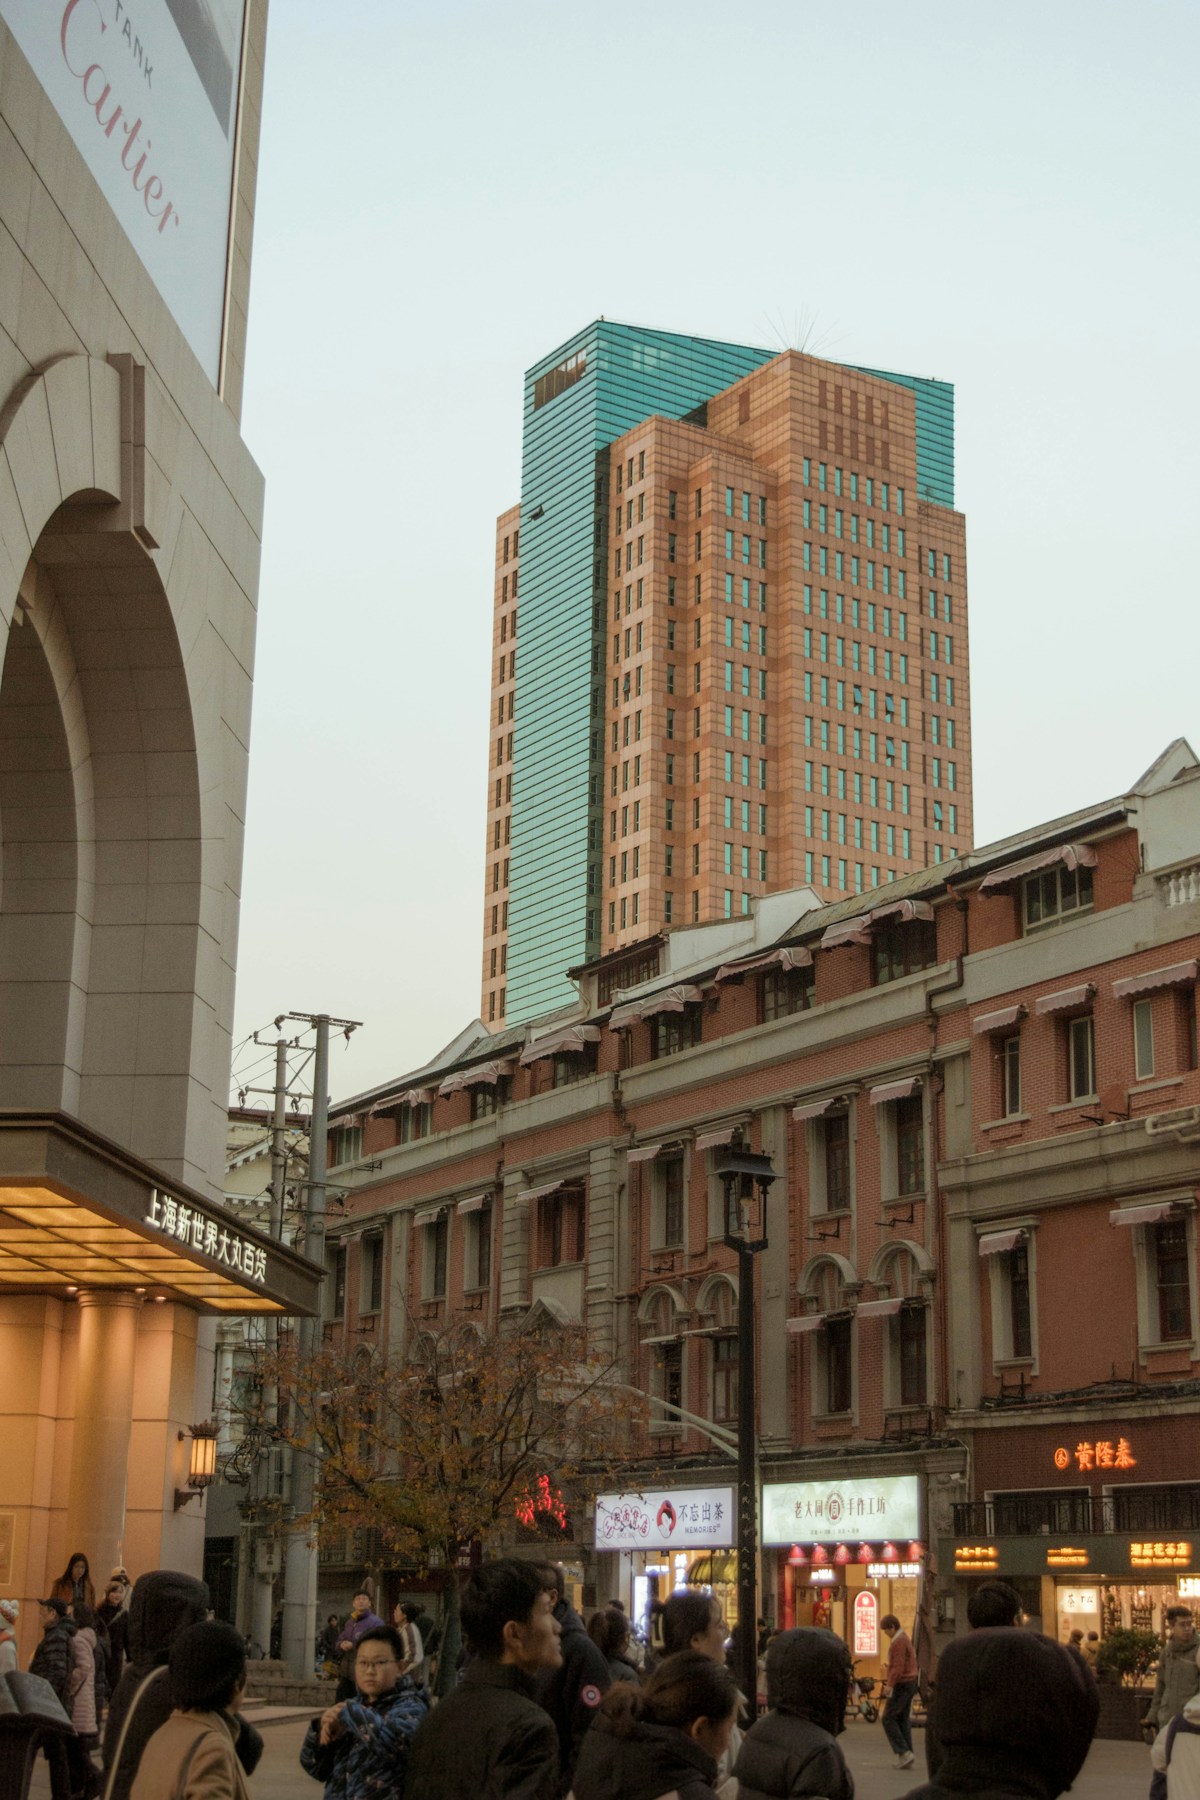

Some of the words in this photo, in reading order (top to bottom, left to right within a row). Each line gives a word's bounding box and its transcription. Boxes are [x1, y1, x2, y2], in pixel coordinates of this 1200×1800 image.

[61, 0, 179, 234] Cartier
[145, 1188, 267, 1283] 上海新世界大丸百货
[1074, 1437, 1136, 1471] 黄隆泰
[678, 1502, 724, 1522] 不忘出茶
[794, 1500, 823, 1519] 老大同
[847, 1496, 887, 1516] 手作工坊
[685, 1525, 717, 1534] MEMORIES
